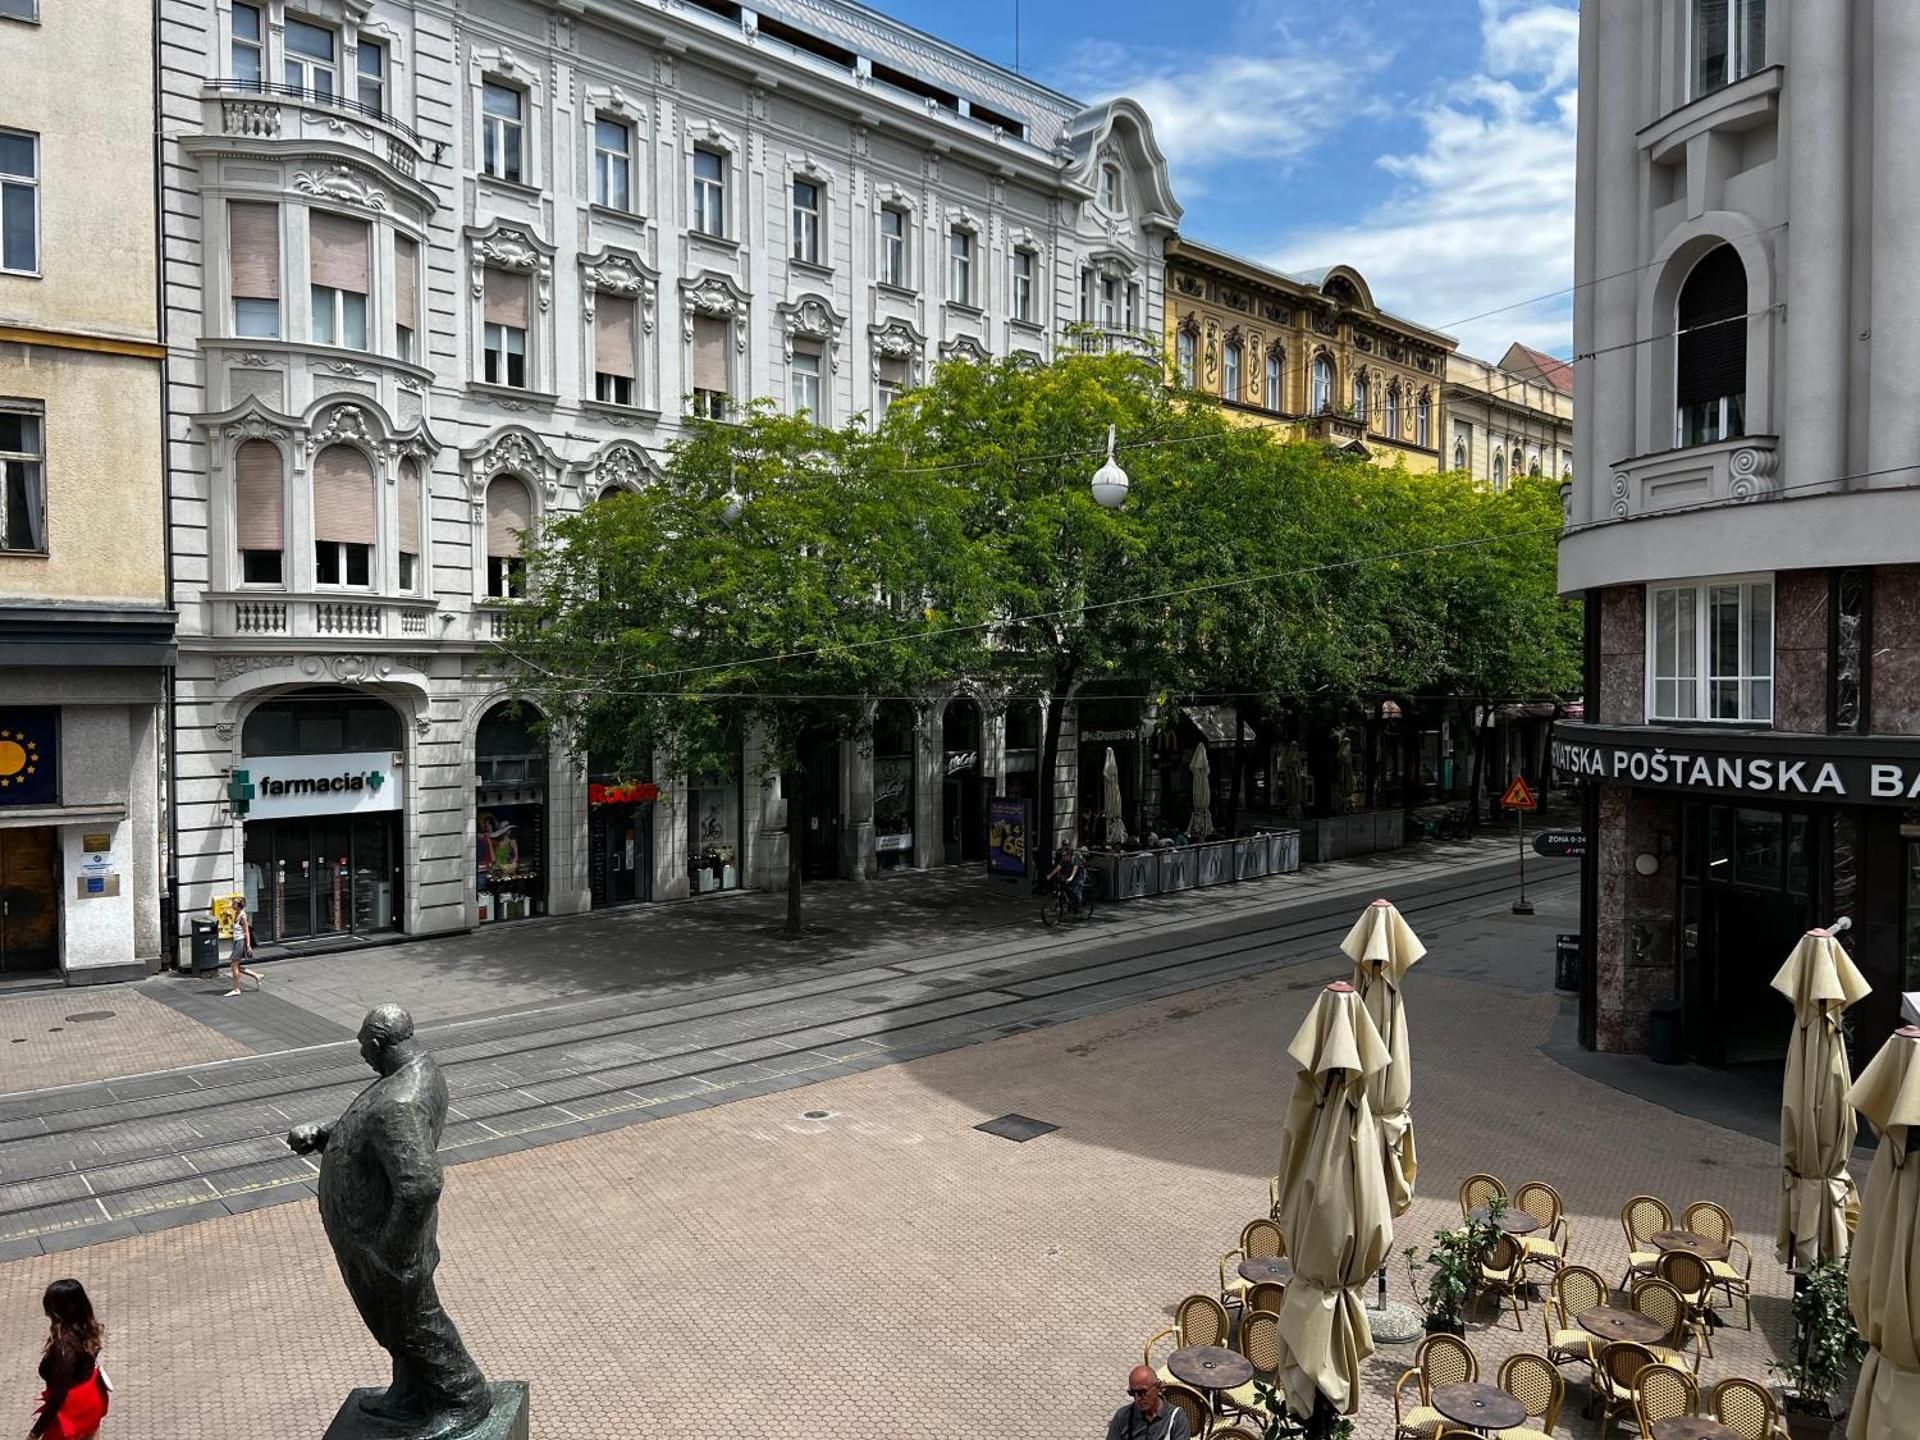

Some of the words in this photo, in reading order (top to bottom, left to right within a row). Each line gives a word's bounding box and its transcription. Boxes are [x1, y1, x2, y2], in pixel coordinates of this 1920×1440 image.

[1613, 748, 1847, 795] POŠTANSKA
[260, 772, 363, 796] farmacia
[1548, 835, 1569, 843] ZONA
